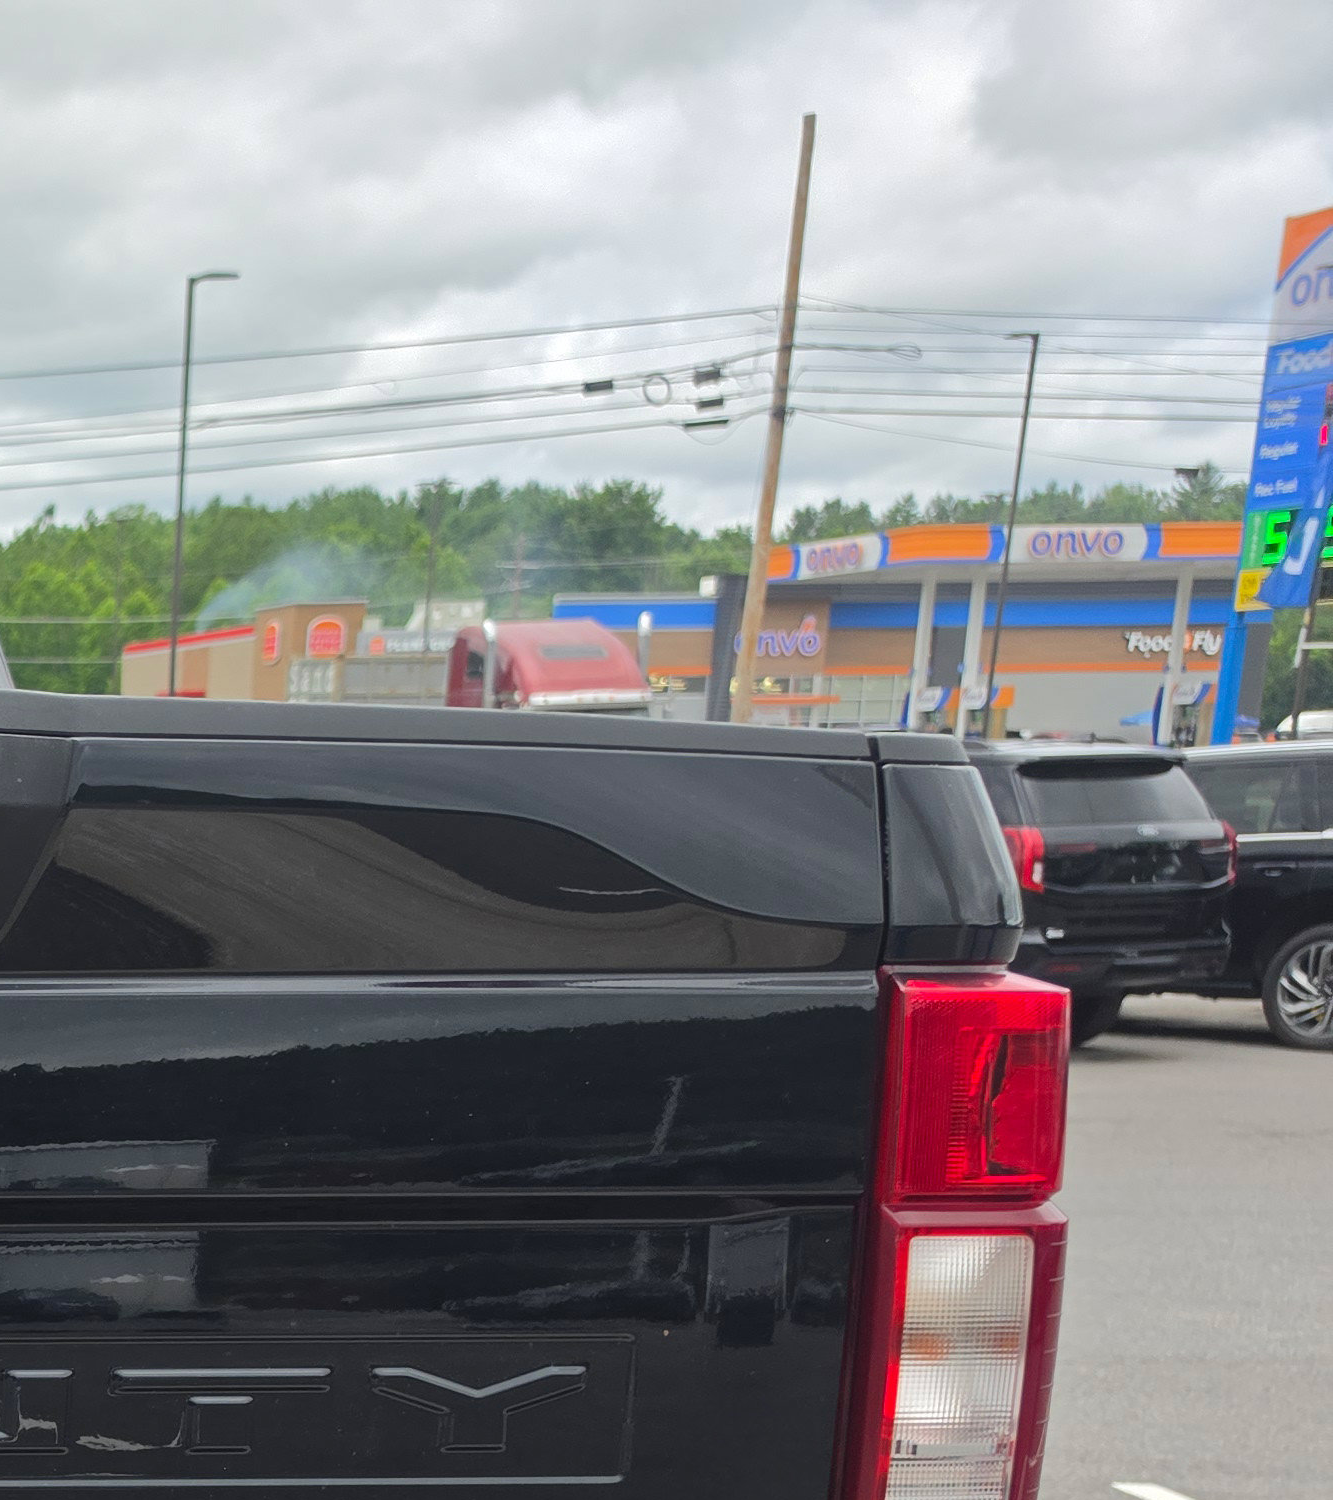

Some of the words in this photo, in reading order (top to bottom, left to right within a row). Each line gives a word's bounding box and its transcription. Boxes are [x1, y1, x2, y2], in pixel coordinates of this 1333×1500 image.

[804, 540, 863, 575] onvo
[1029, 529, 1127, 559] onvo
[1192, 629, 1222, 656] Fly
